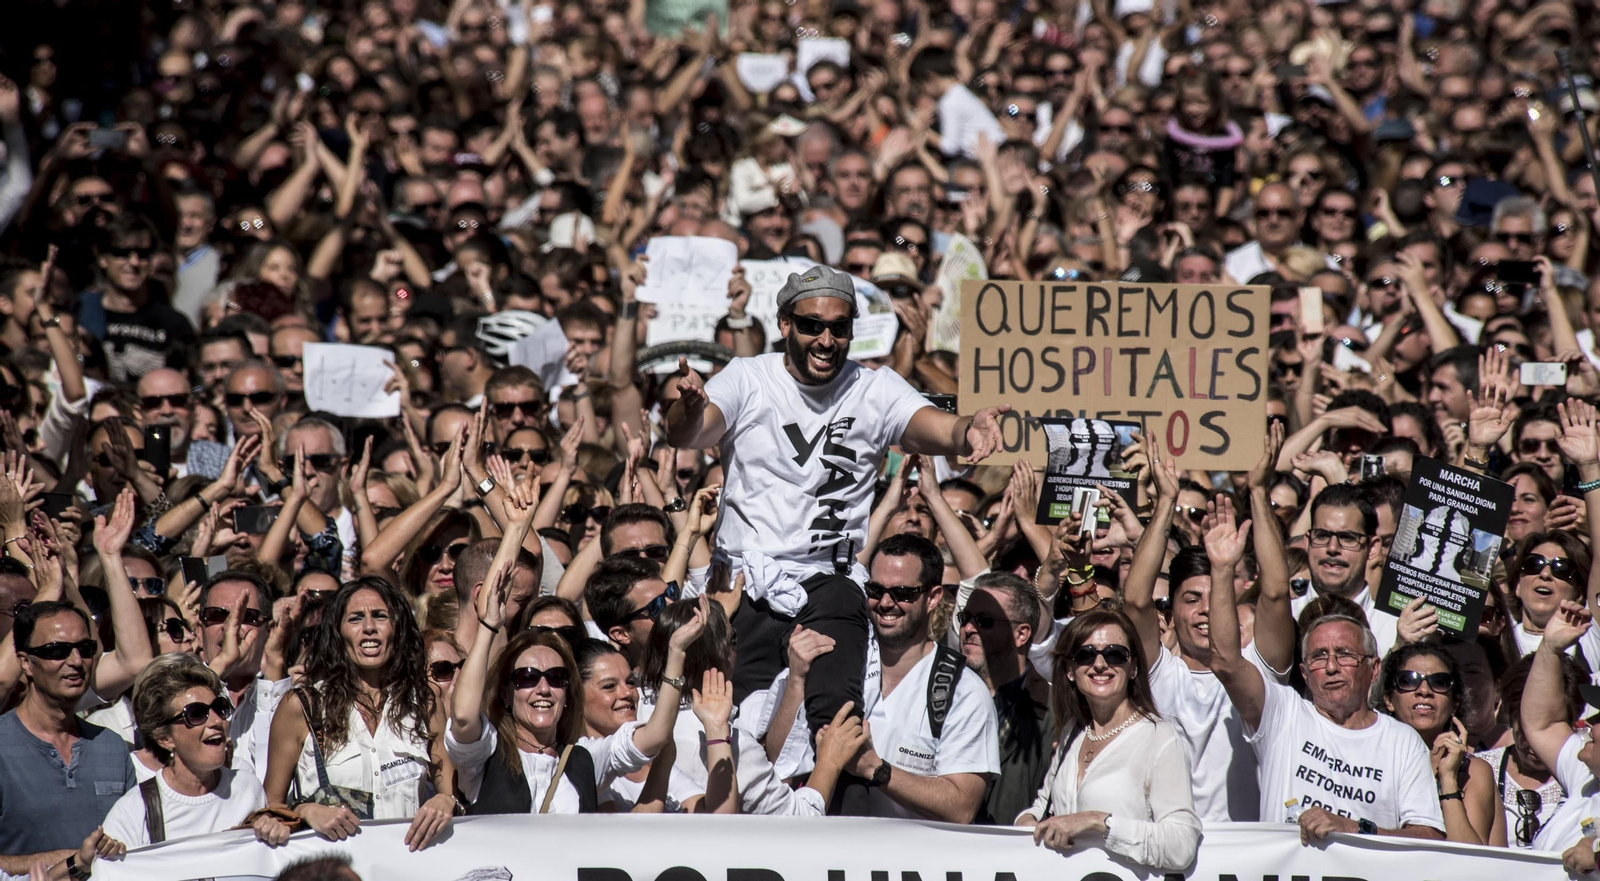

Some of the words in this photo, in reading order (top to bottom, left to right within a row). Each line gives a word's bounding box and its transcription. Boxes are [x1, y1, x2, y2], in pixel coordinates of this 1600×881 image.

[975, 282, 1255, 340] QUEREMOS
[973, 346, 1262, 402] HOSPITALES
[1048, 476, 1072, 485] QUEREMOS
[1102, 480, 1130, 489] NUESTROS
[1419, 476, 1432, 488] POR
[1432, 482, 1445, 493] UNA
[1446, 487, 1475, 503] SANIDAD
[1475, 497, 1497, 511] DIGNA
[1439, 469, 1480, 491] MARCHA
[1428, 491, 1446, 505] PARA
[1446, 498, 1478, 516] GRANADA
[1389, 561, 1417, 578] QUEREMOS
[1417, 572, 1450, 589] RECUPERAR
[1450, 582, 1481, 599] NUESTROS
[1396, 574, 1401, 582] 2
[1401, 575, 1433, 593] HOSPITALES
[1433, 587, 1467, 605] COMPLETOS,
[1397, 584, 1424, 598] SEGUROS
[1428, 594, 1462, 612] INTEGRALES
[898, 746, 935, 760] ORGANIZA
[1302, 741, 1383, 782] EMIGRANTE
[1295, 764, 1376, 804] RETORNAO
